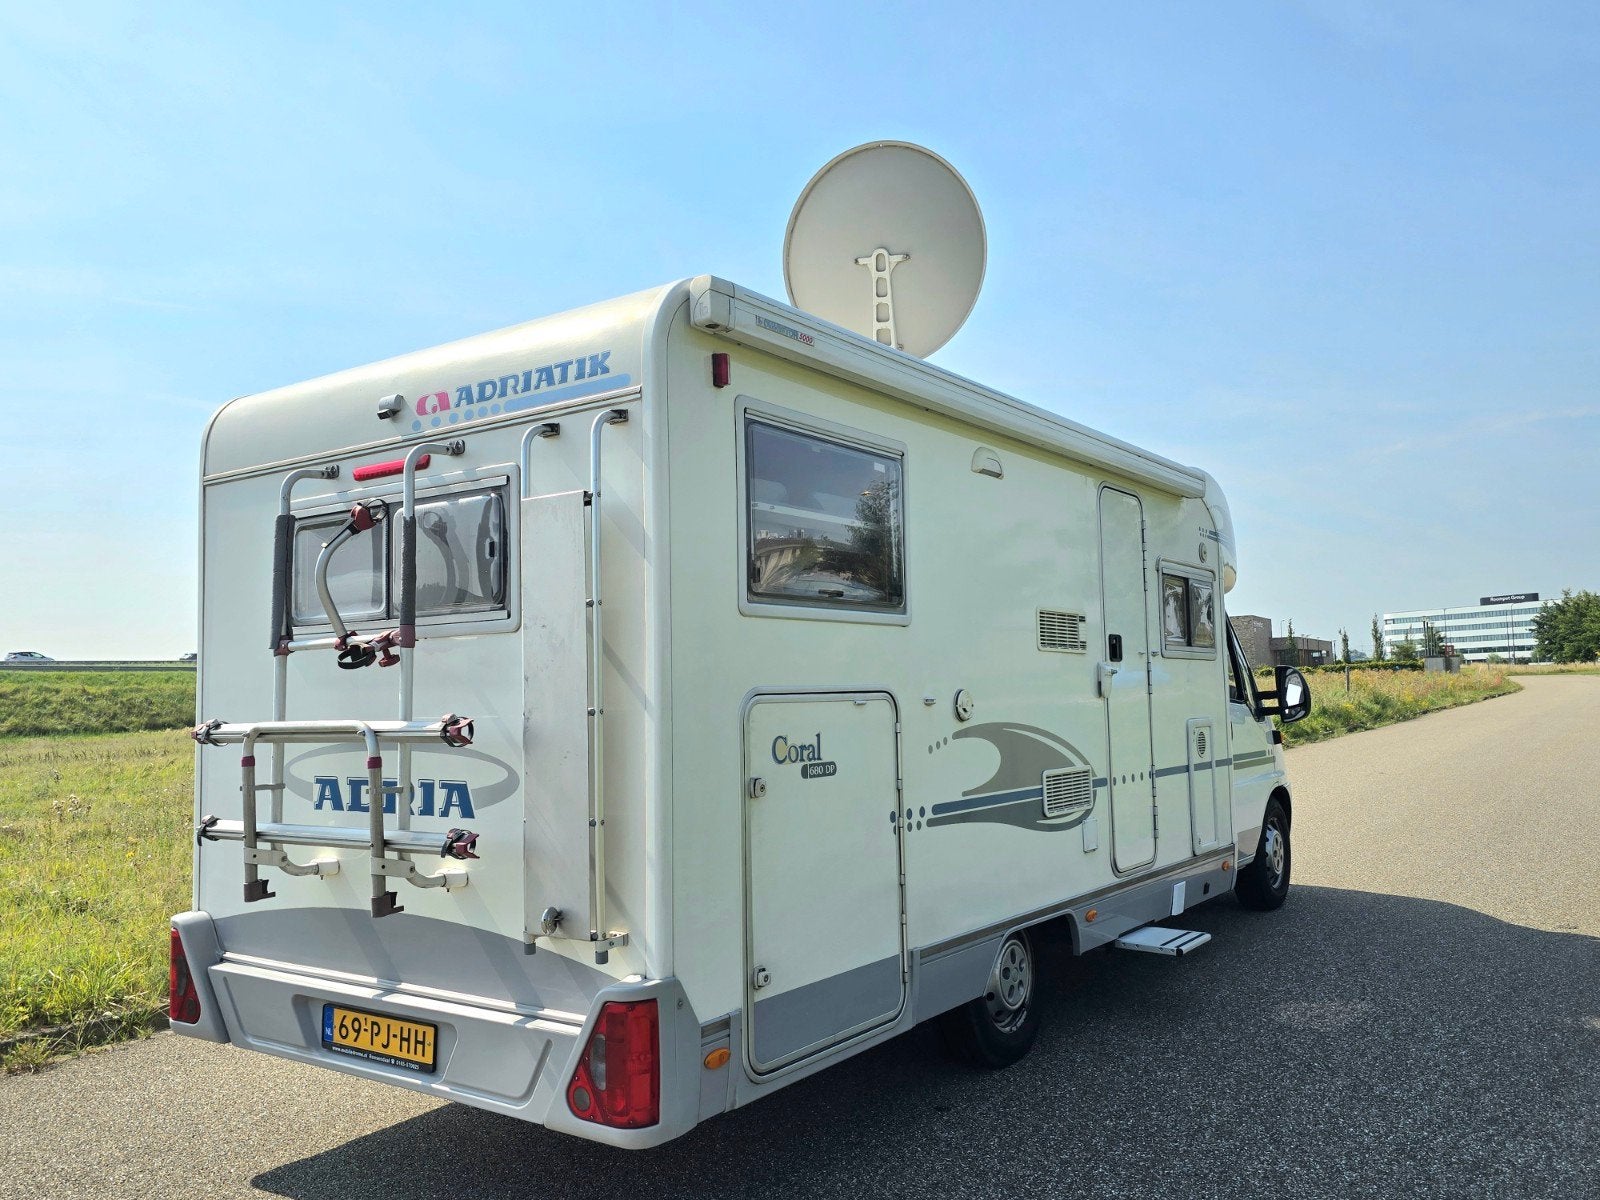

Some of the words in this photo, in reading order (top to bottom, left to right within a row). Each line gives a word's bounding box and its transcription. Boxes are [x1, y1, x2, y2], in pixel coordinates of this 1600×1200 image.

[799, 332, 814, 344] 5000
[454, 350, 611, 408] ADRIATIK
[771, 732, 823, 765] Coral
[809, 765, 824, 776] 680
[825, 764, 836, 774] DP
[325, 1027, 333, 1036] NL
